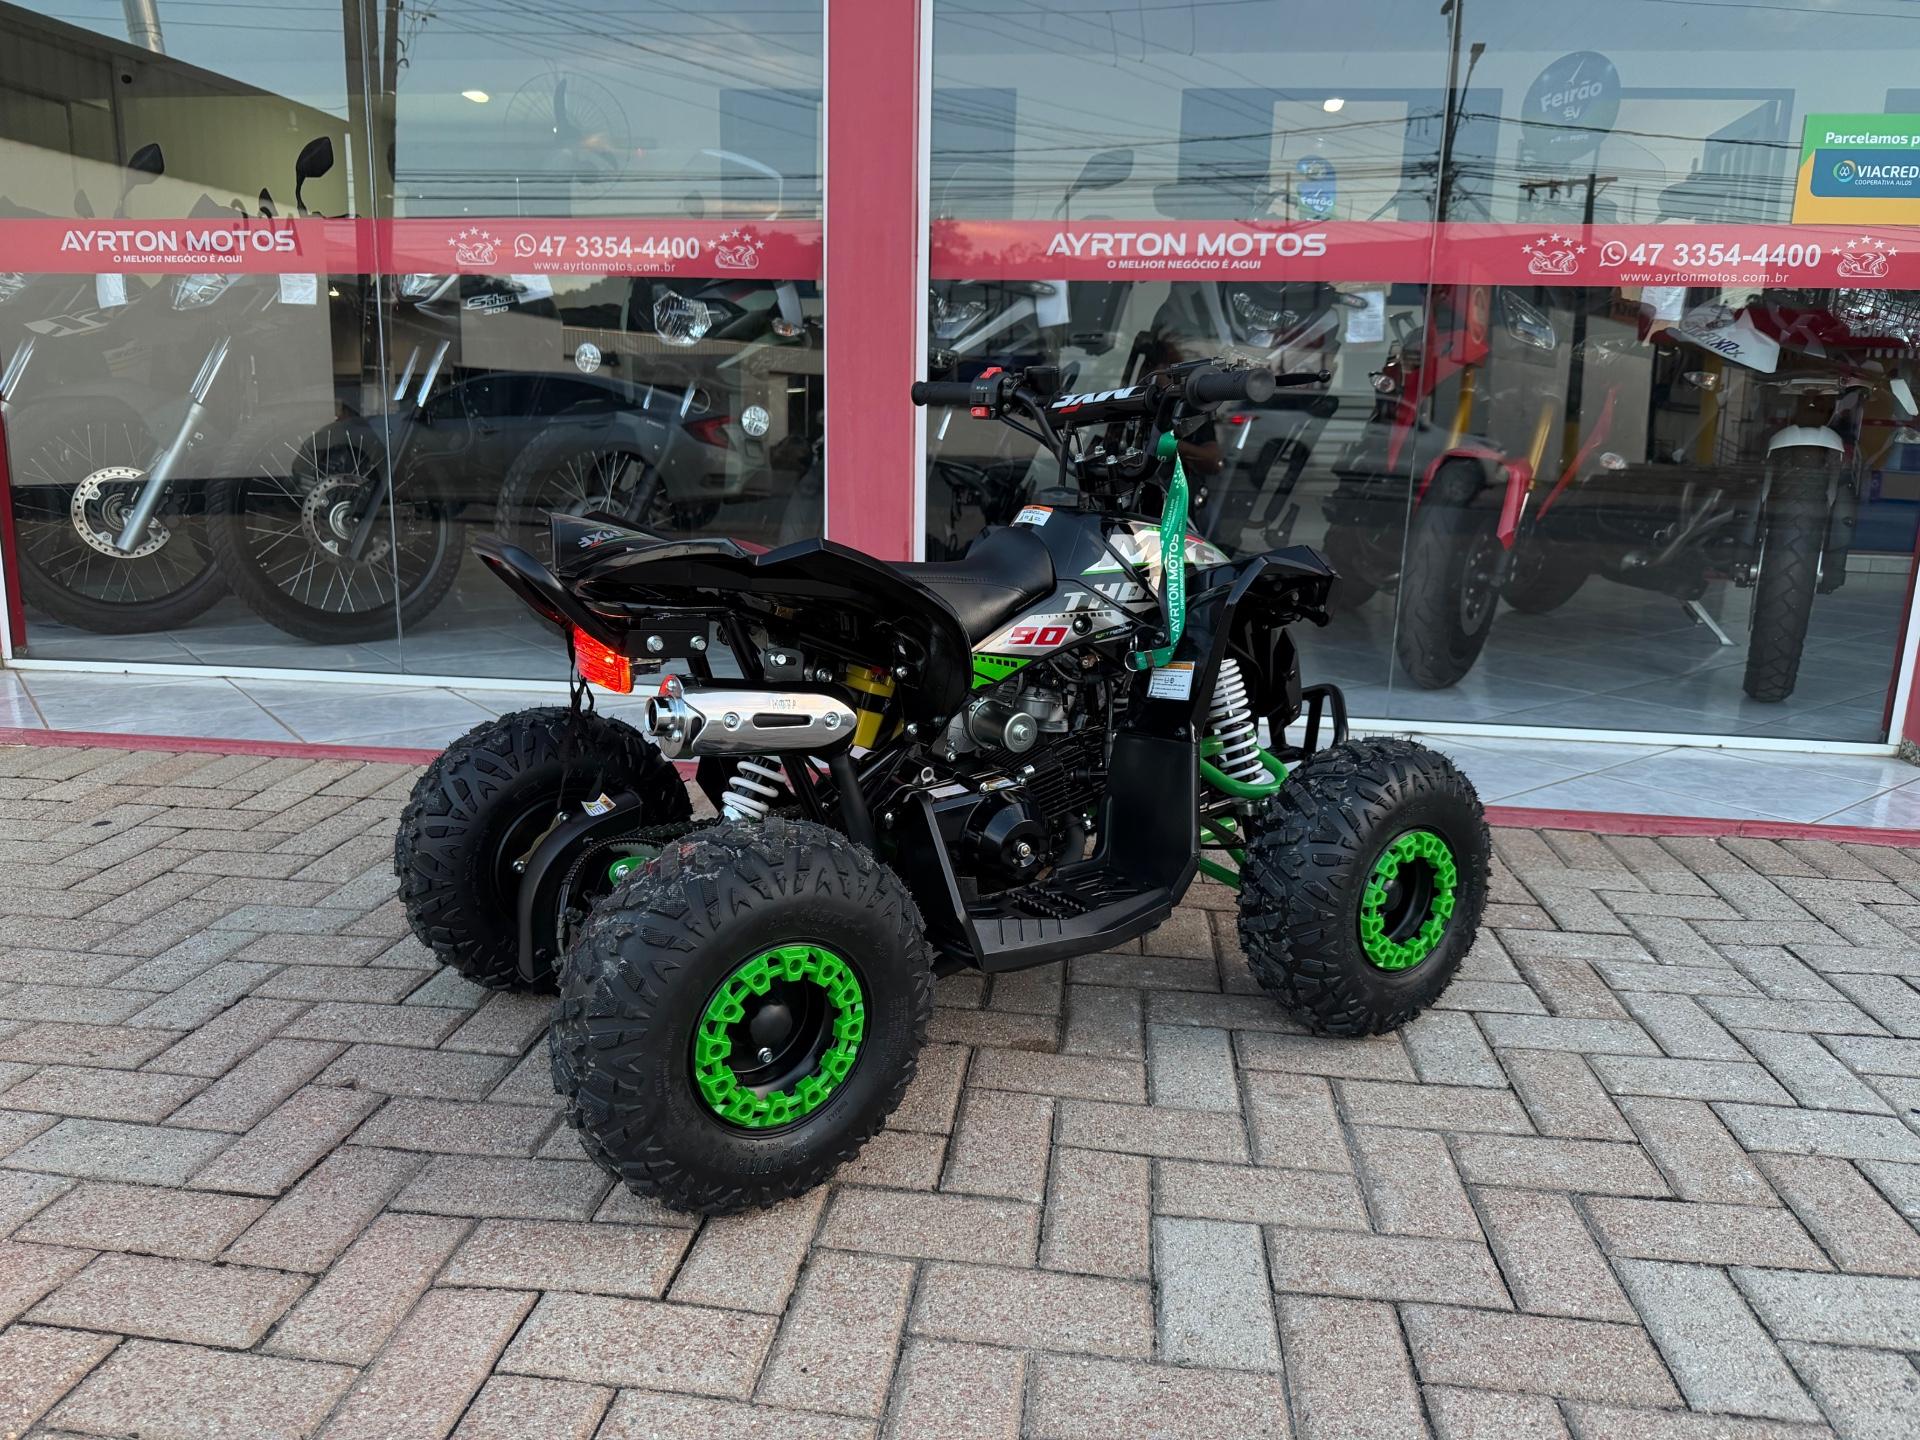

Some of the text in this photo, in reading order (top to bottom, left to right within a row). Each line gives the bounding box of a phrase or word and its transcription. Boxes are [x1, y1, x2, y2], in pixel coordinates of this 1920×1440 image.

[1540, 80, 1603, 113] Feirão
[1825, 132, 1908, 145] Parcelamos
[1857, 165, 1920, 178] VIACRED
[61, 230, 296, 253] AYRTON MOTOS
[539, 236, 700, 260] 47 3354-4400
[1046, 232, 1328, 257] AYRTON MOTOS
[113, 255, 122, 263] O
[123, 255, 162, 263] MELHOR
[164, 253, 208, 263] NEGÓCIO
[217, 255, 243, 263] AQUI
[1107, 258, 1262, 270] O MELHOR NEGÓCIO É AQUI
[1629, 243, 1822, 268] 47 3354-4400
[533, 261, 676, 273] www.ayrtonmotos.com.br
[1620, 270, 1790, 284] www.ayrtonmotos.com.br
[1168, 533, 1180, 580] MOTOS
[1168, 582, 1180, 633] AYRTON
[1008, 626, 1068, 645] 90
